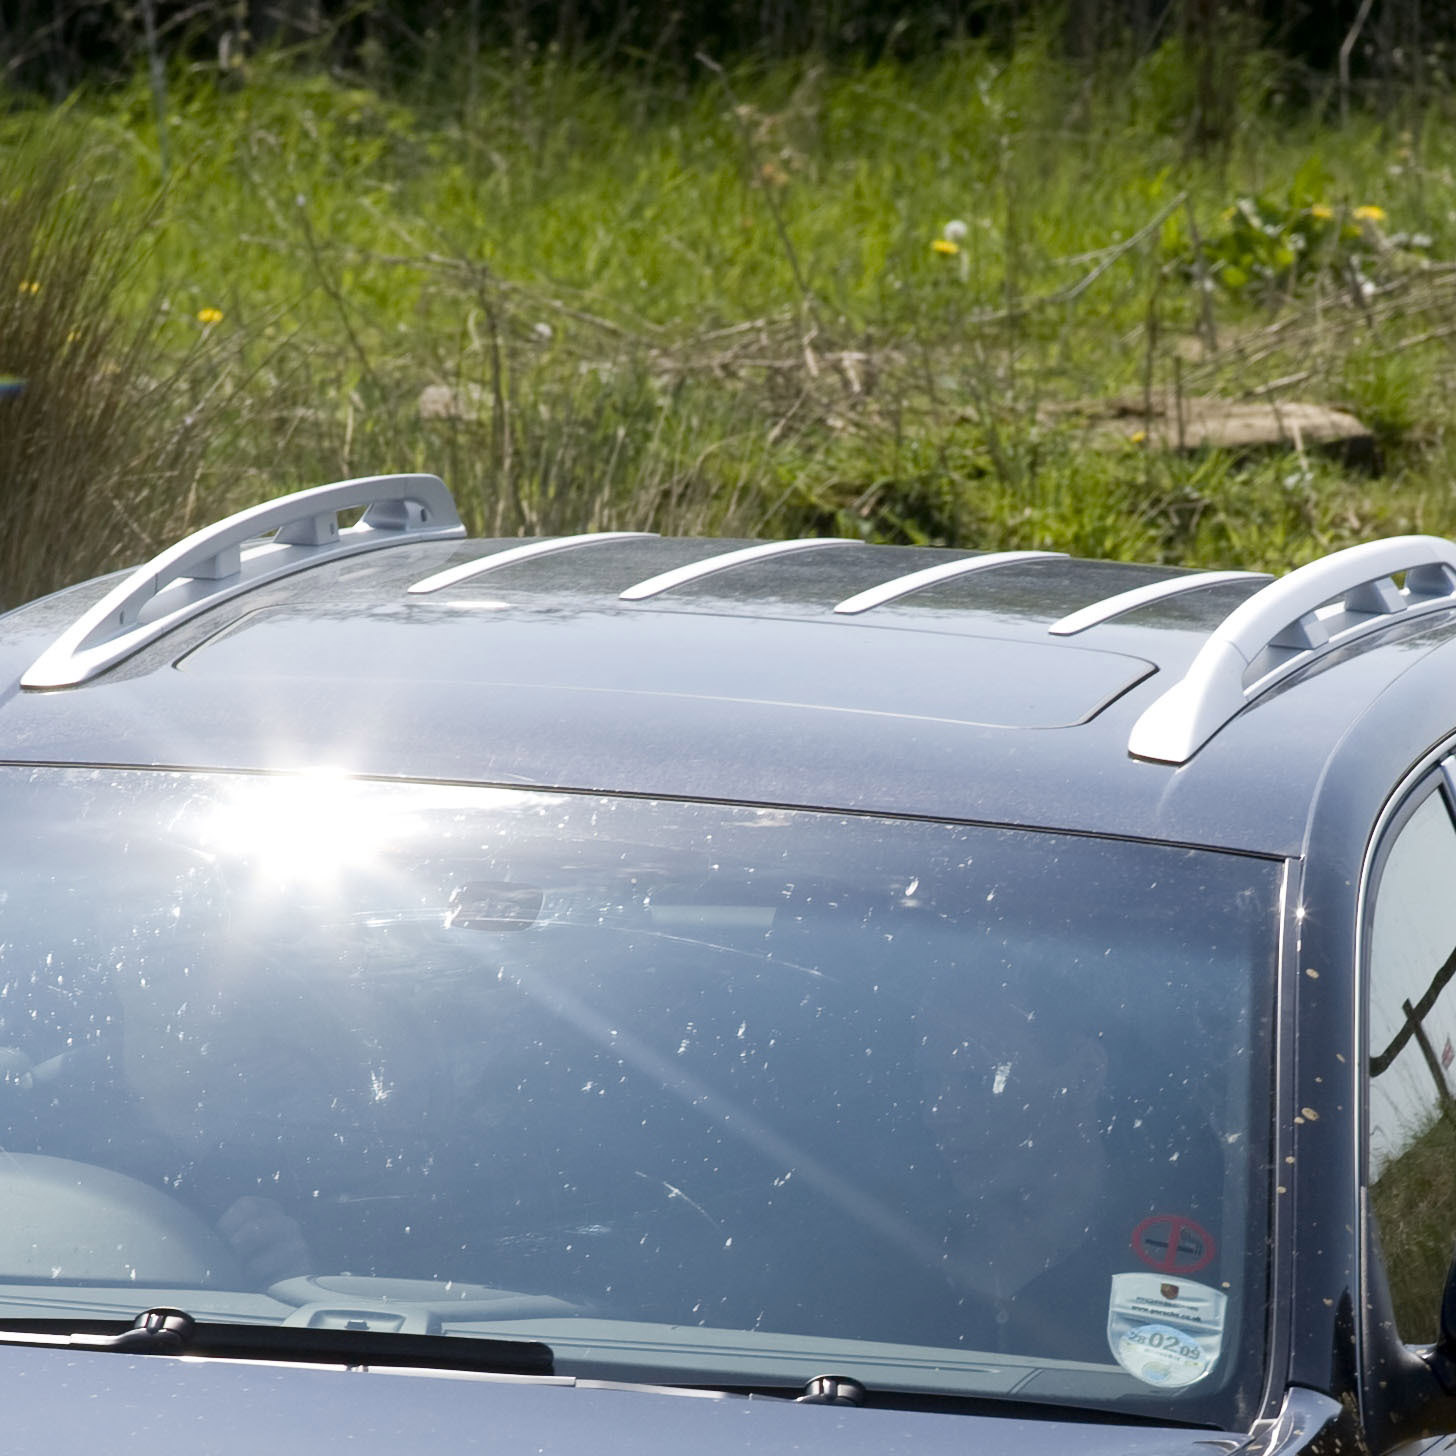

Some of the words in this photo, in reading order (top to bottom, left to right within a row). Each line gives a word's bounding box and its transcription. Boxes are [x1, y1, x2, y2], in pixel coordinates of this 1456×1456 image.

[1128, 1330, 1146, 1344] 28
[1149, 1332, 1180, 1353] 02
[1180, 1346, 1201, 1360] 09
